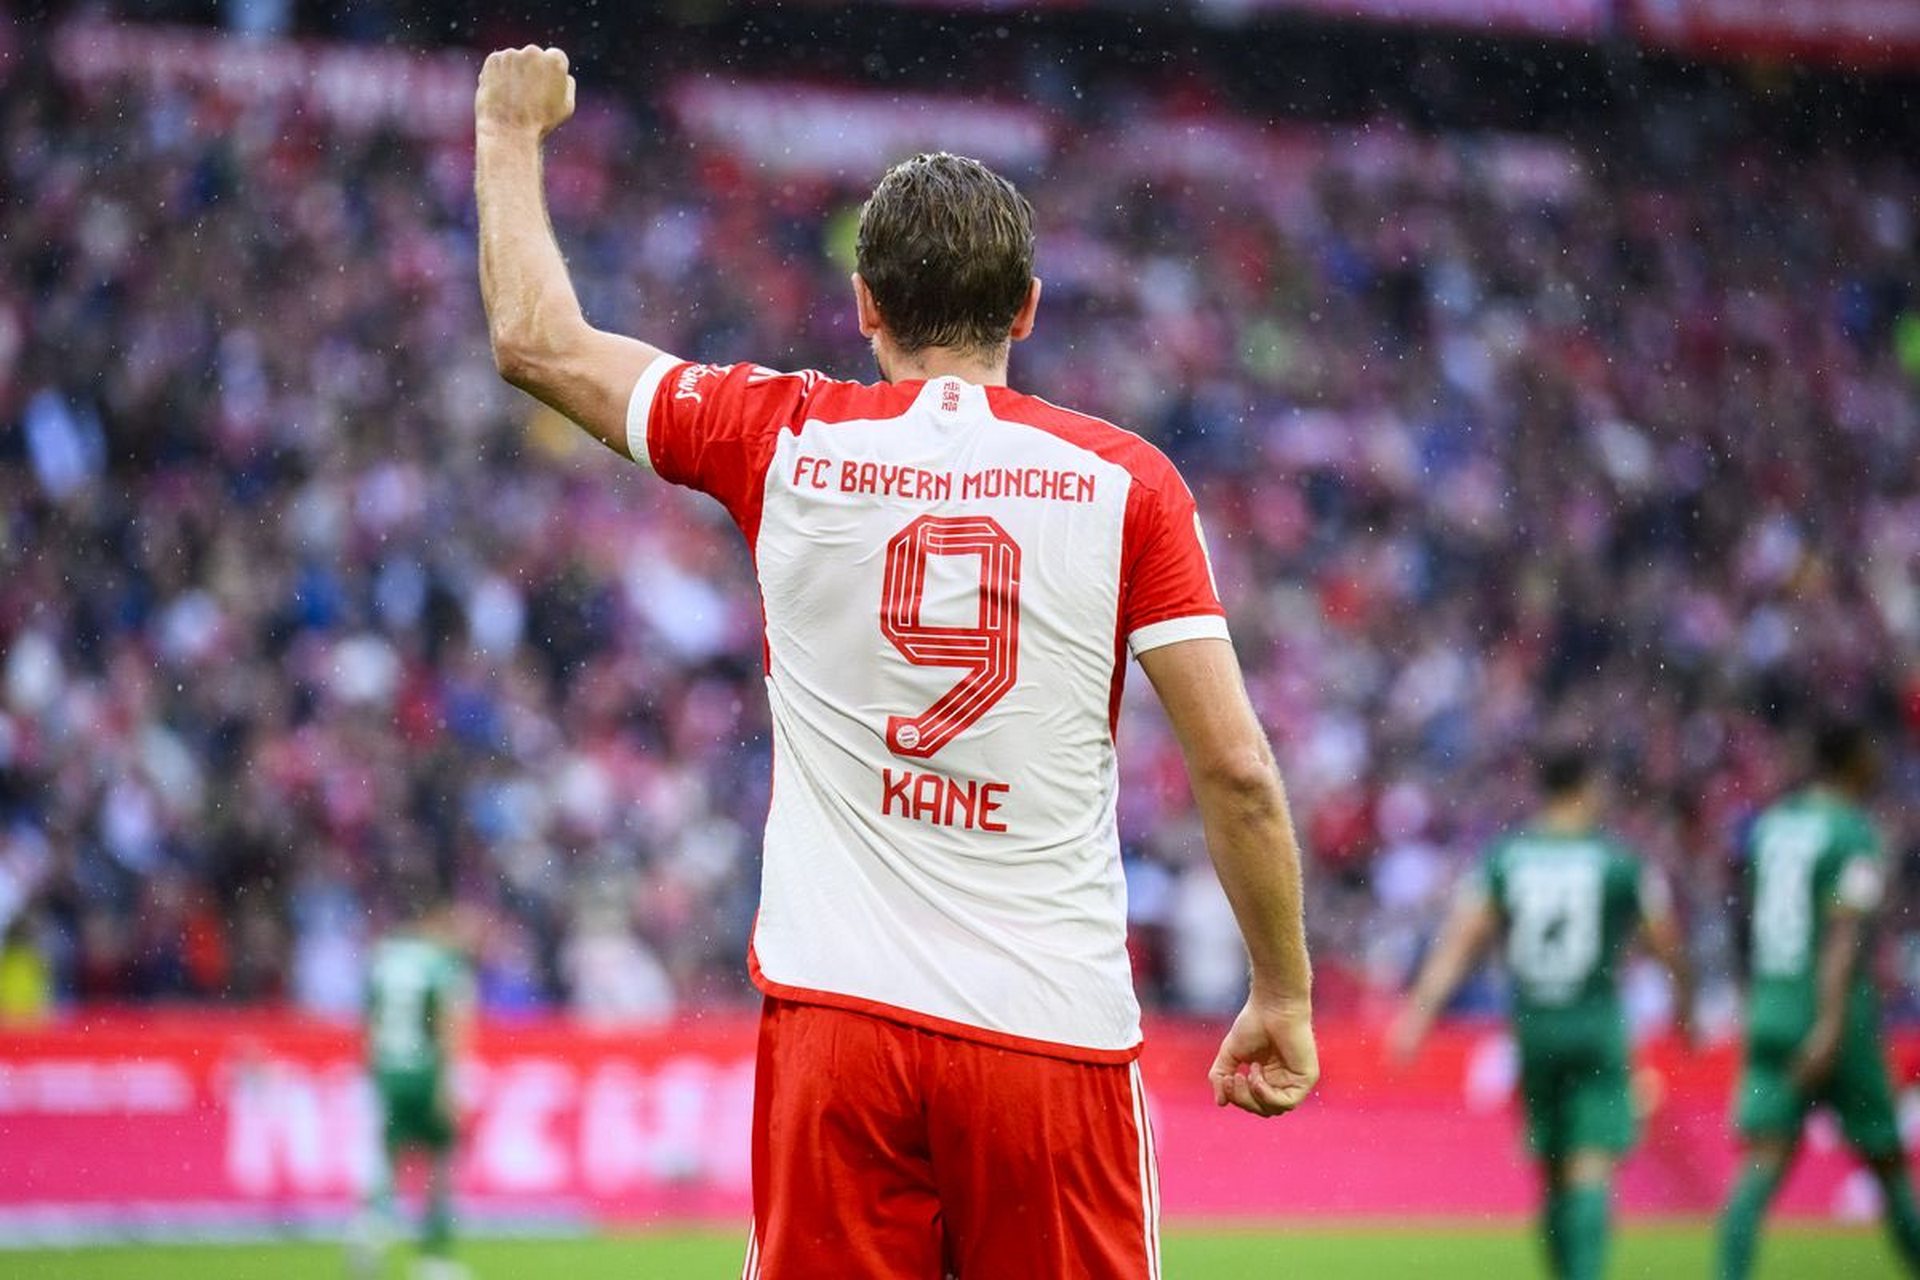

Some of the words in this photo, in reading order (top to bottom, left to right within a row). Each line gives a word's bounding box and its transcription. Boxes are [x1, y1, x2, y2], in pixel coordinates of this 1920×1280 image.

[793, 456, 831, 489] FC
[840, 460, 952, 501] BAYERN
[962, 468, 1095, 502] MÜNCHEN
[880, 514, 1021, 758] 9
[882, 768, 1009, 832] KANE
